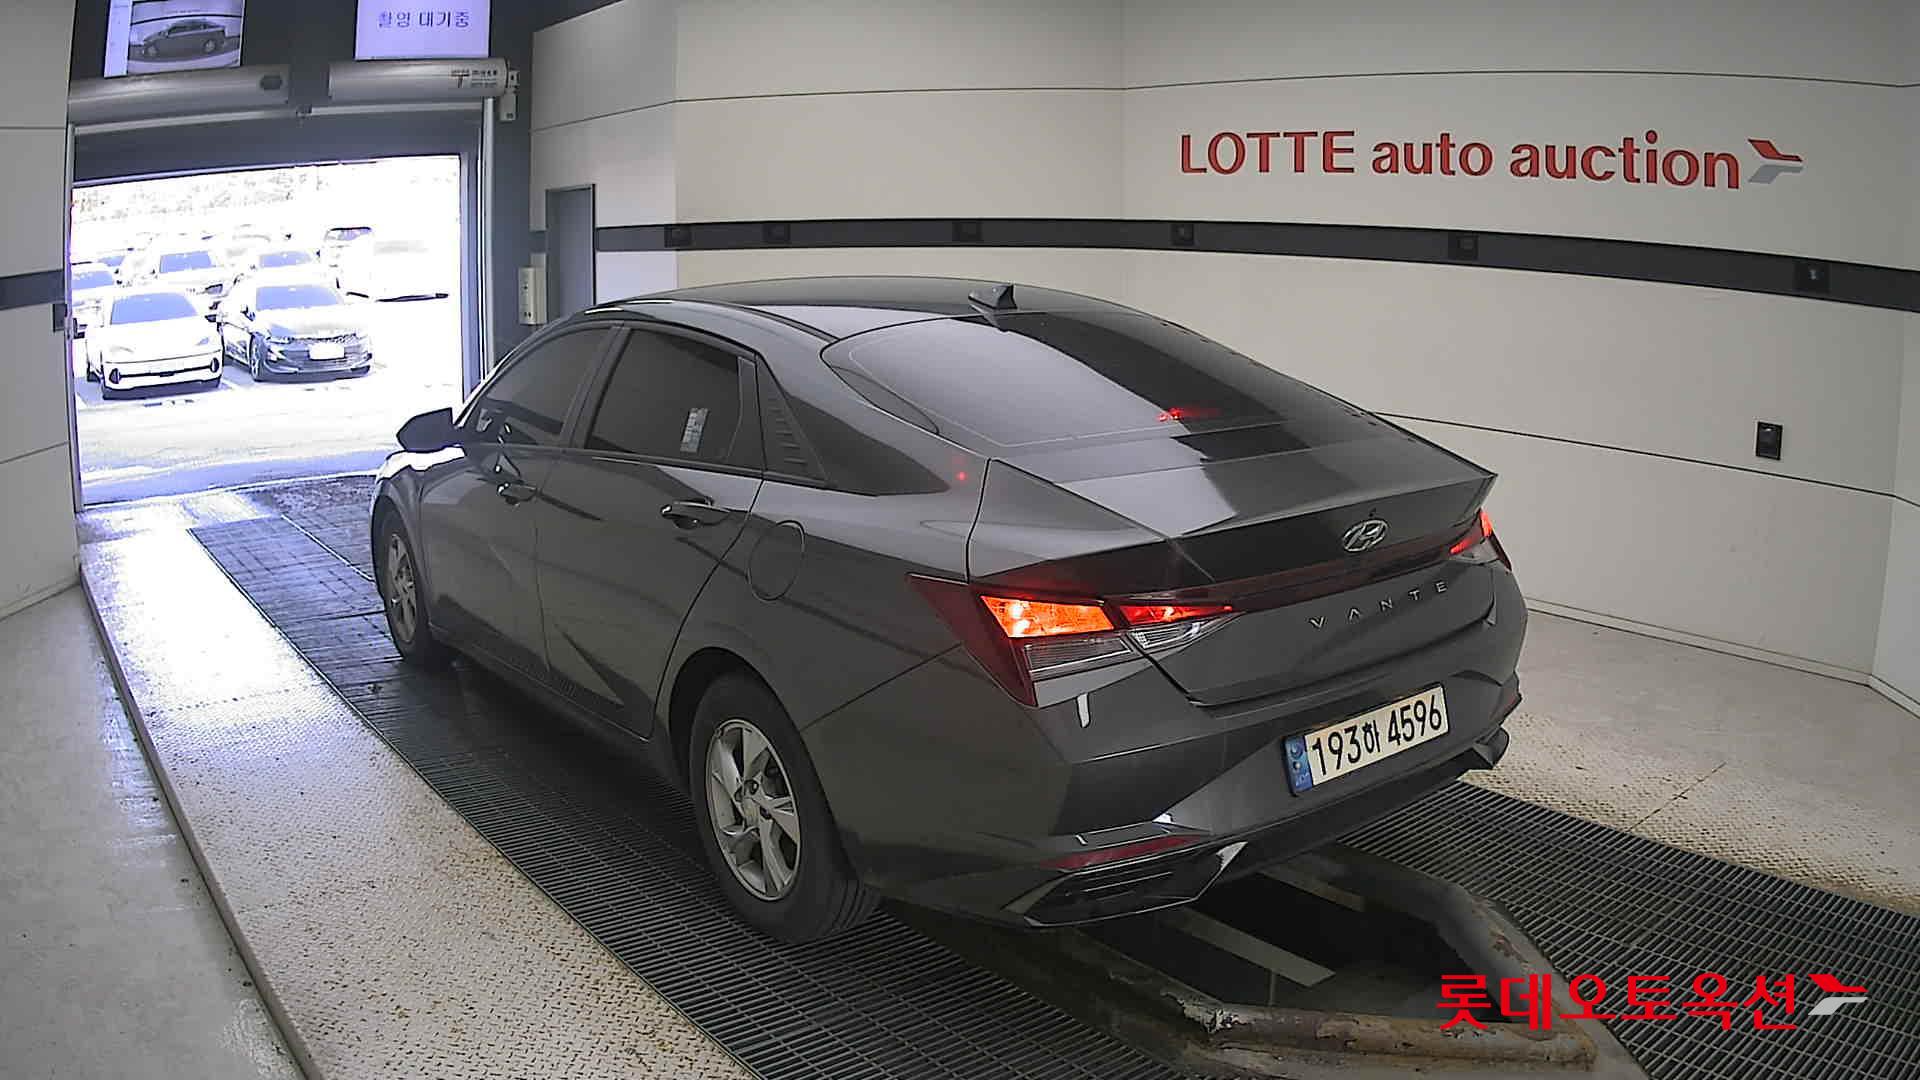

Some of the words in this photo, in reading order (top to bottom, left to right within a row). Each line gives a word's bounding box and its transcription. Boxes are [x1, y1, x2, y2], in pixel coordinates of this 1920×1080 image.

[419, 11, 469, 28] 대기중
[1180, 130, 1356, 175] LOTTE
[1371, 132, 1494, 176] auto
[1509, 130, 1741, 190] auction
[1311, 719, 1380, 776] 193하
[1387, 695, 1442, 746] 4596
